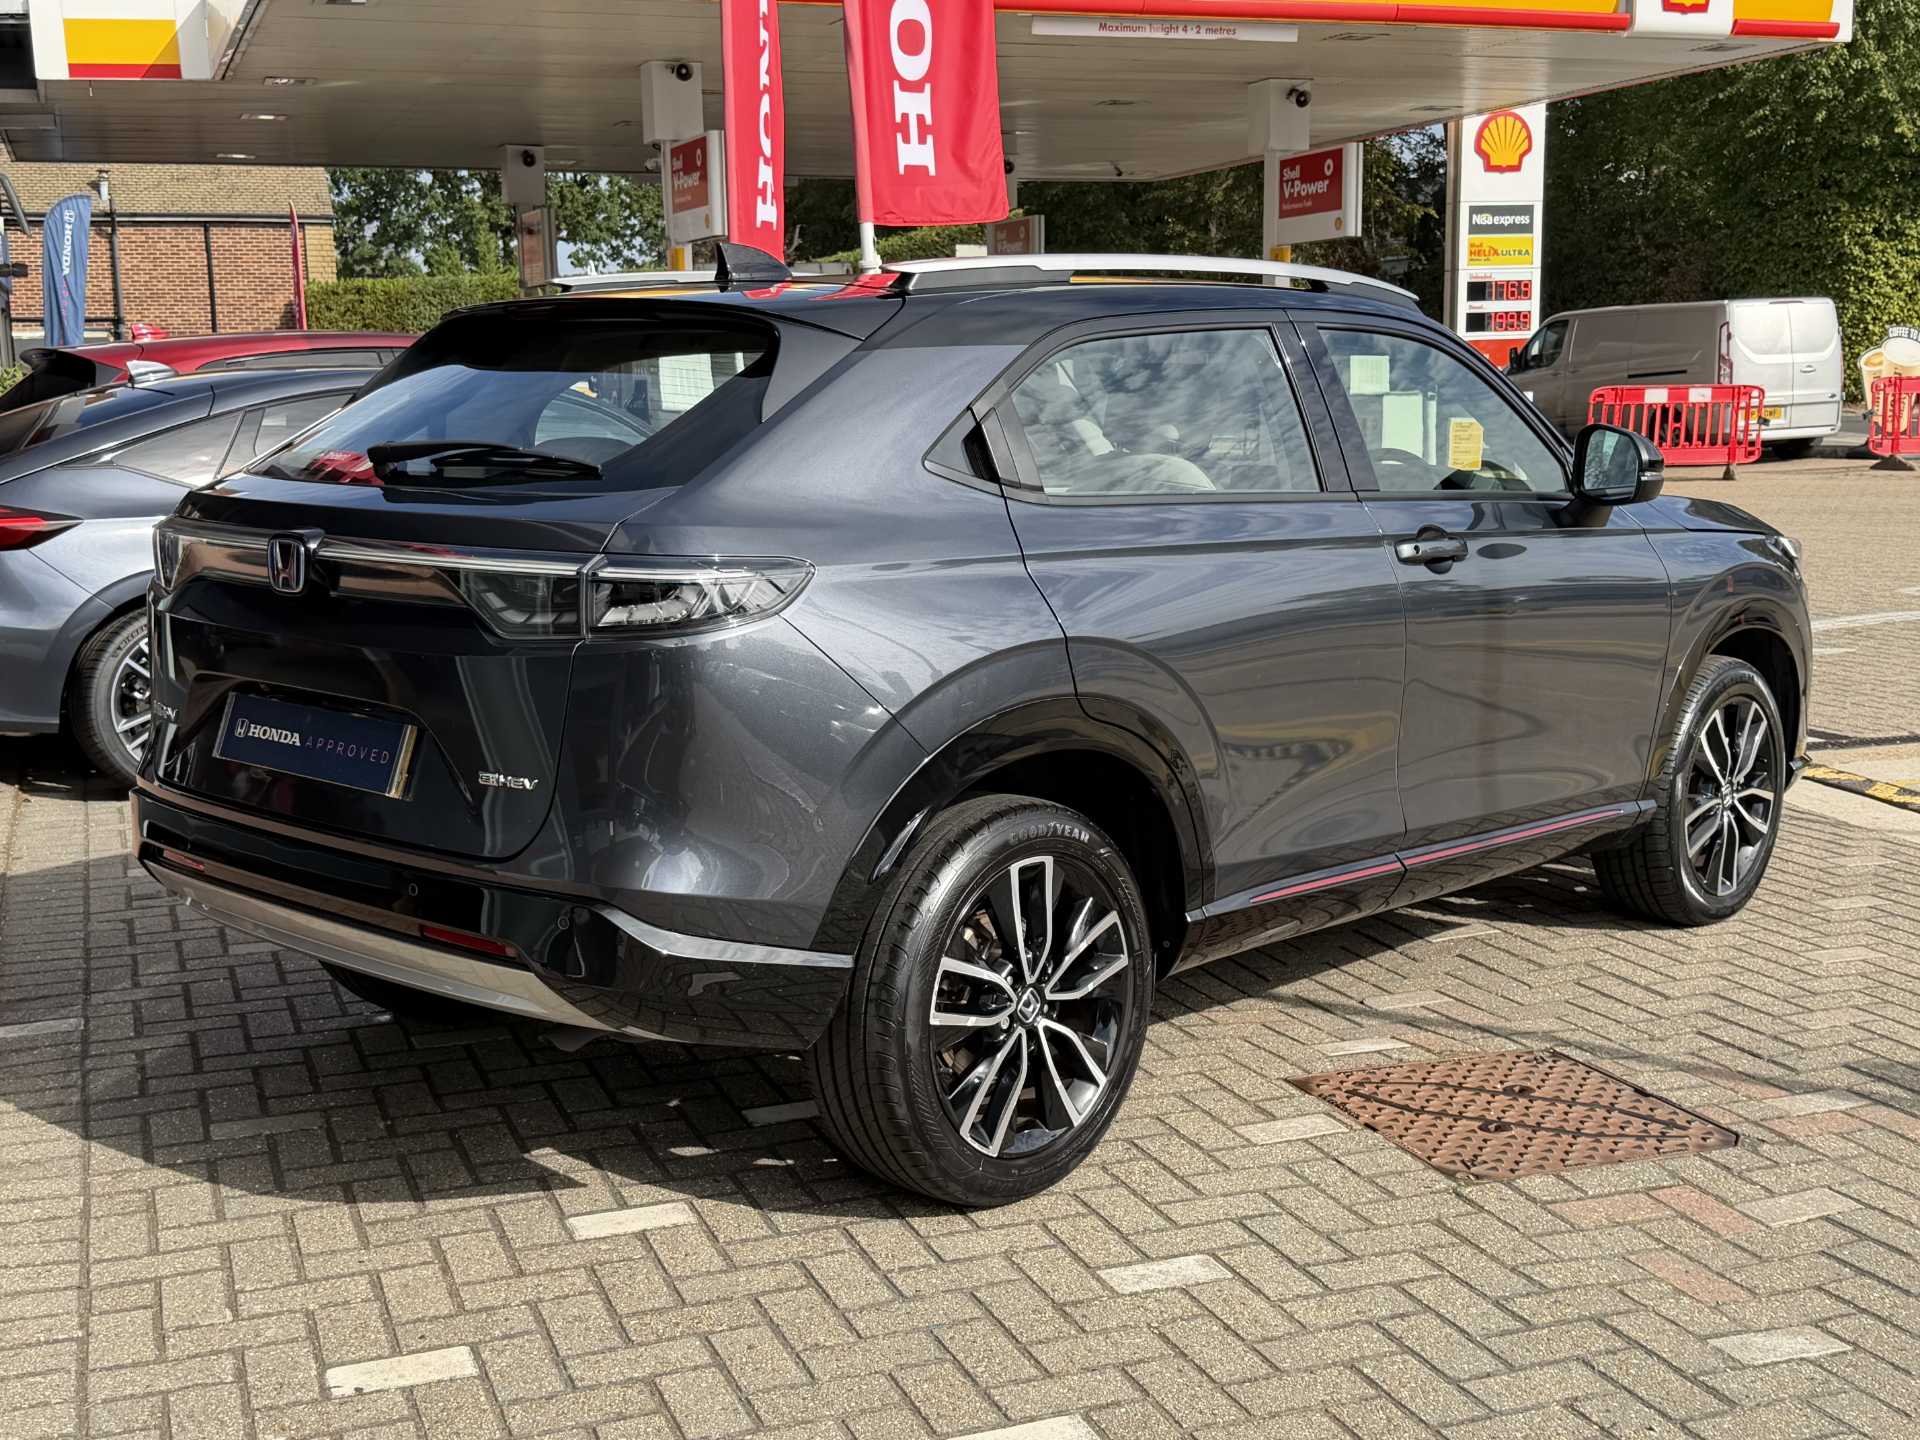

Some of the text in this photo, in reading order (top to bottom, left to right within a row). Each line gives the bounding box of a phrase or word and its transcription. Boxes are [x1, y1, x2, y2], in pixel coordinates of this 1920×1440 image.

[1098, 22, 1146, 33] Maximum
[1205, 25, 1236, 35] metres
[1282, 165, 1300, 181] Shell
[1283, 180, 1330, 200] V-Power
[1493, 214, 1530, 227] express
[1500, 249, 1530, 257] ULTRA
[1889, 326, 1909, 338] COFFEE
[248, 723, 390, 765] HONDA APPROVED
